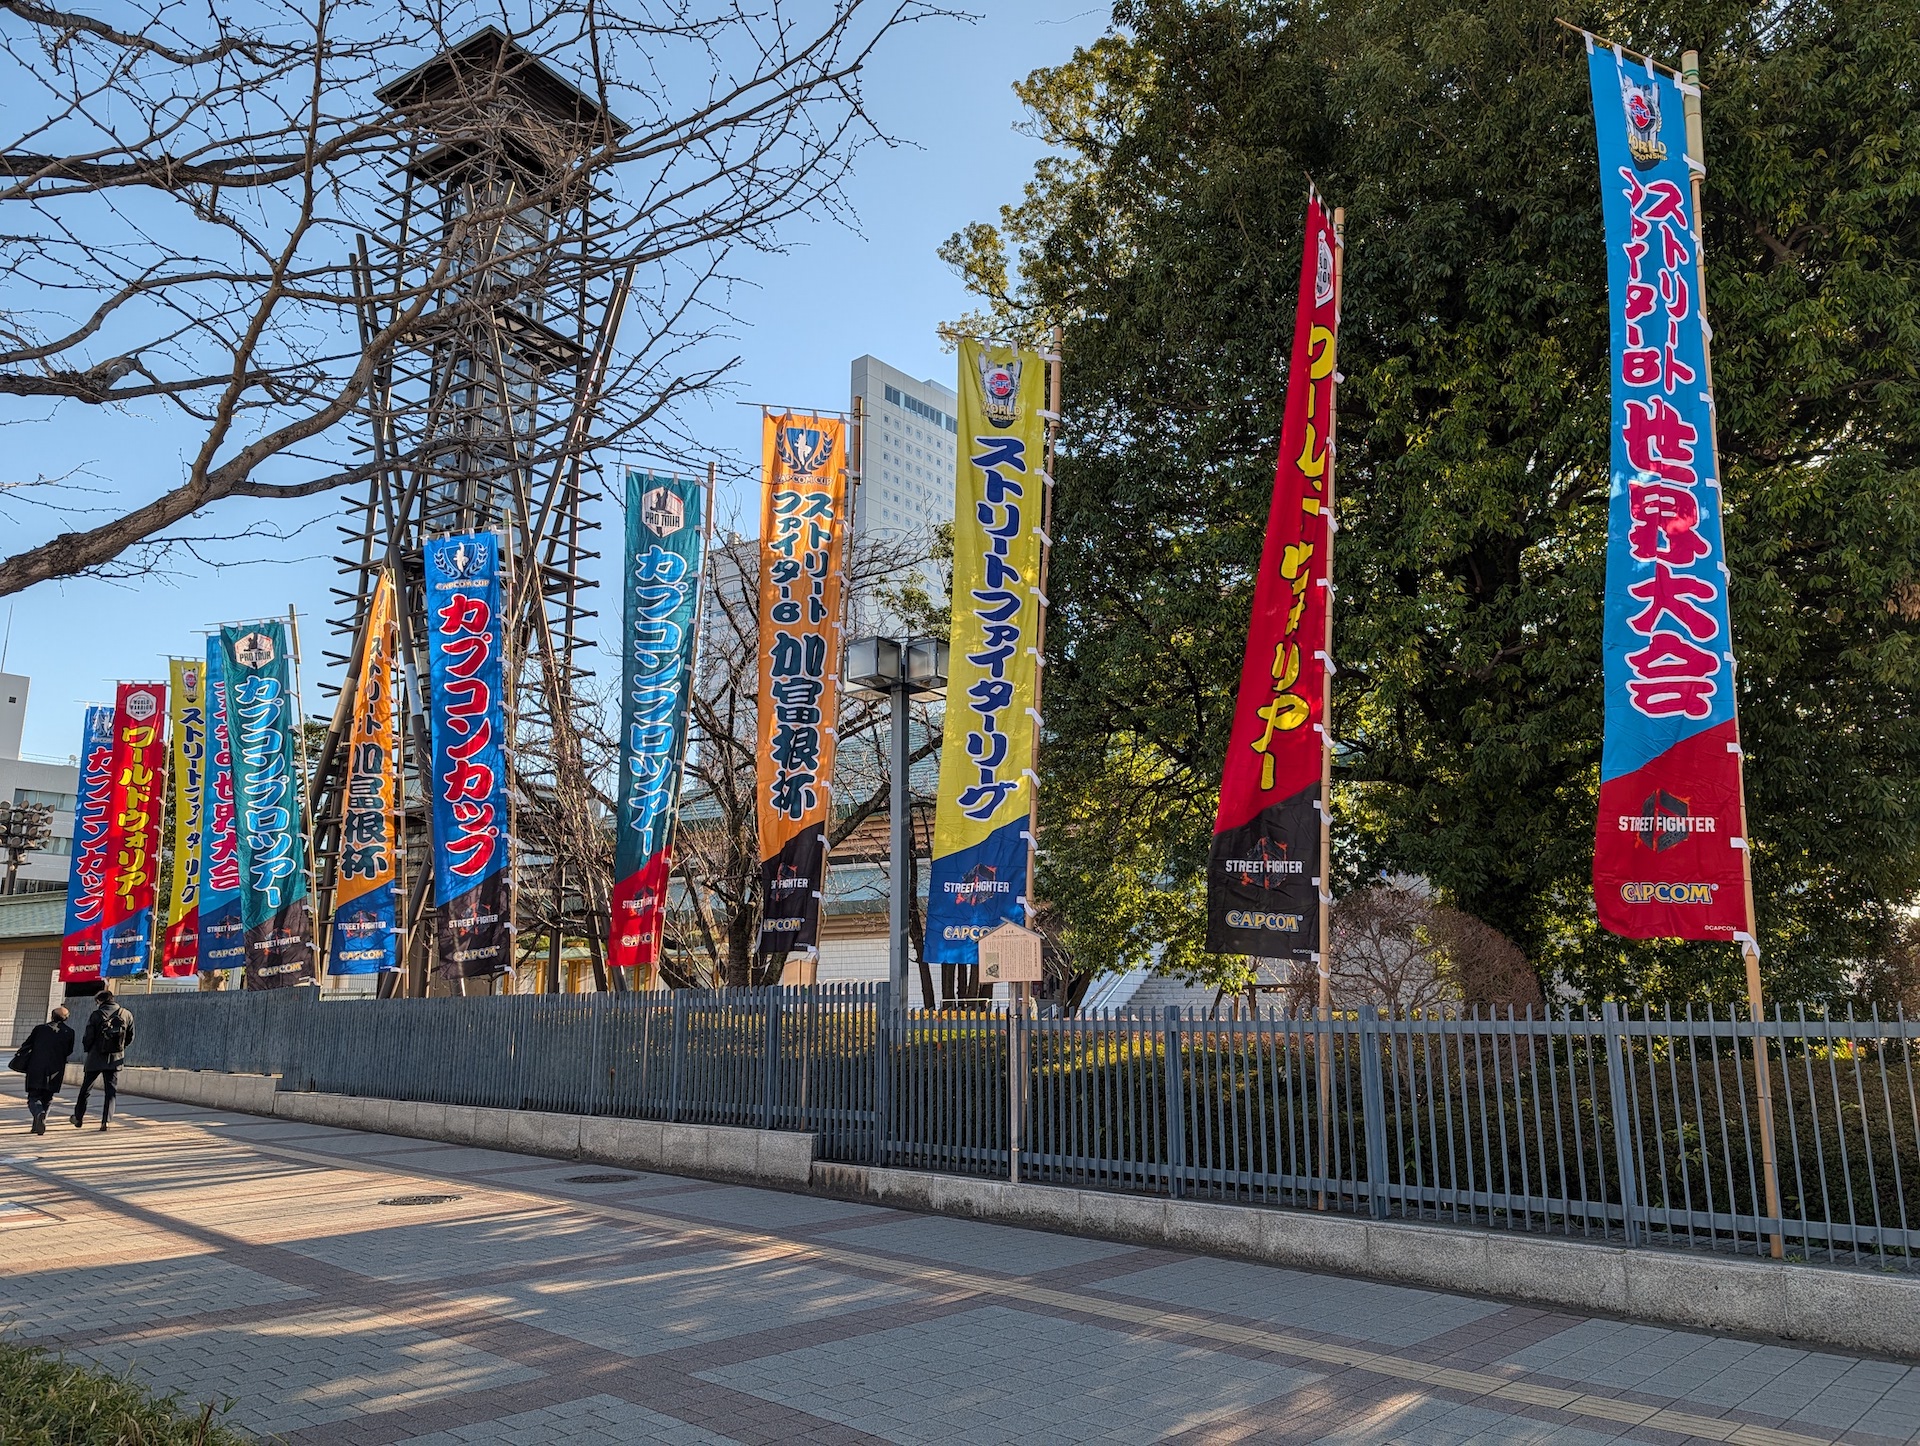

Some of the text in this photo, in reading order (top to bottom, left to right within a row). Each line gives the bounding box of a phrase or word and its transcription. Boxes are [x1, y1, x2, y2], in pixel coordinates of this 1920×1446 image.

[1643, 178, 1696, 396] ストリート
[814, 476, 833, 486] CUP
[645, 511, 680, 528] PRO TOUR
[769, 491, 802, 624] ファイター6
[802, 492, 834, 624] ストリート
[1622, 394, 1721, 720] 世界大会
[957, 434, 1027, 822] ストリートファイターリーグ
[628, 545, 688, 856] カプコンプロツアー
[438, 593, 499, 877] カプコンカップ
[235, 675, 297, 908] カプコンプロツアー
[115, 726, 155, 911] ワールドウォリアー
[1618, 816, 1716, 833] STREET FIGHTER
[1225, 860, 1303, 873] STREET FIGHTER
[778, 878, 808, 888] FIGHTER
[944, 882, 975, 893] STREET
[1621, 882, 1713, 905] CAPCOM
[448, 914, 499, 928] STREET FIGHTER
[1226, 910, 1299, 932] CAPCOM
[943, 925, 996, 941] CAPCO
[254, 936, 300, 949] STREET FIGHTER
[339, 949, 384, 961] CAPCOM
[453, 946, 498, 962] CAPCOM
[258, 962, 302, 977] CAPCOM
